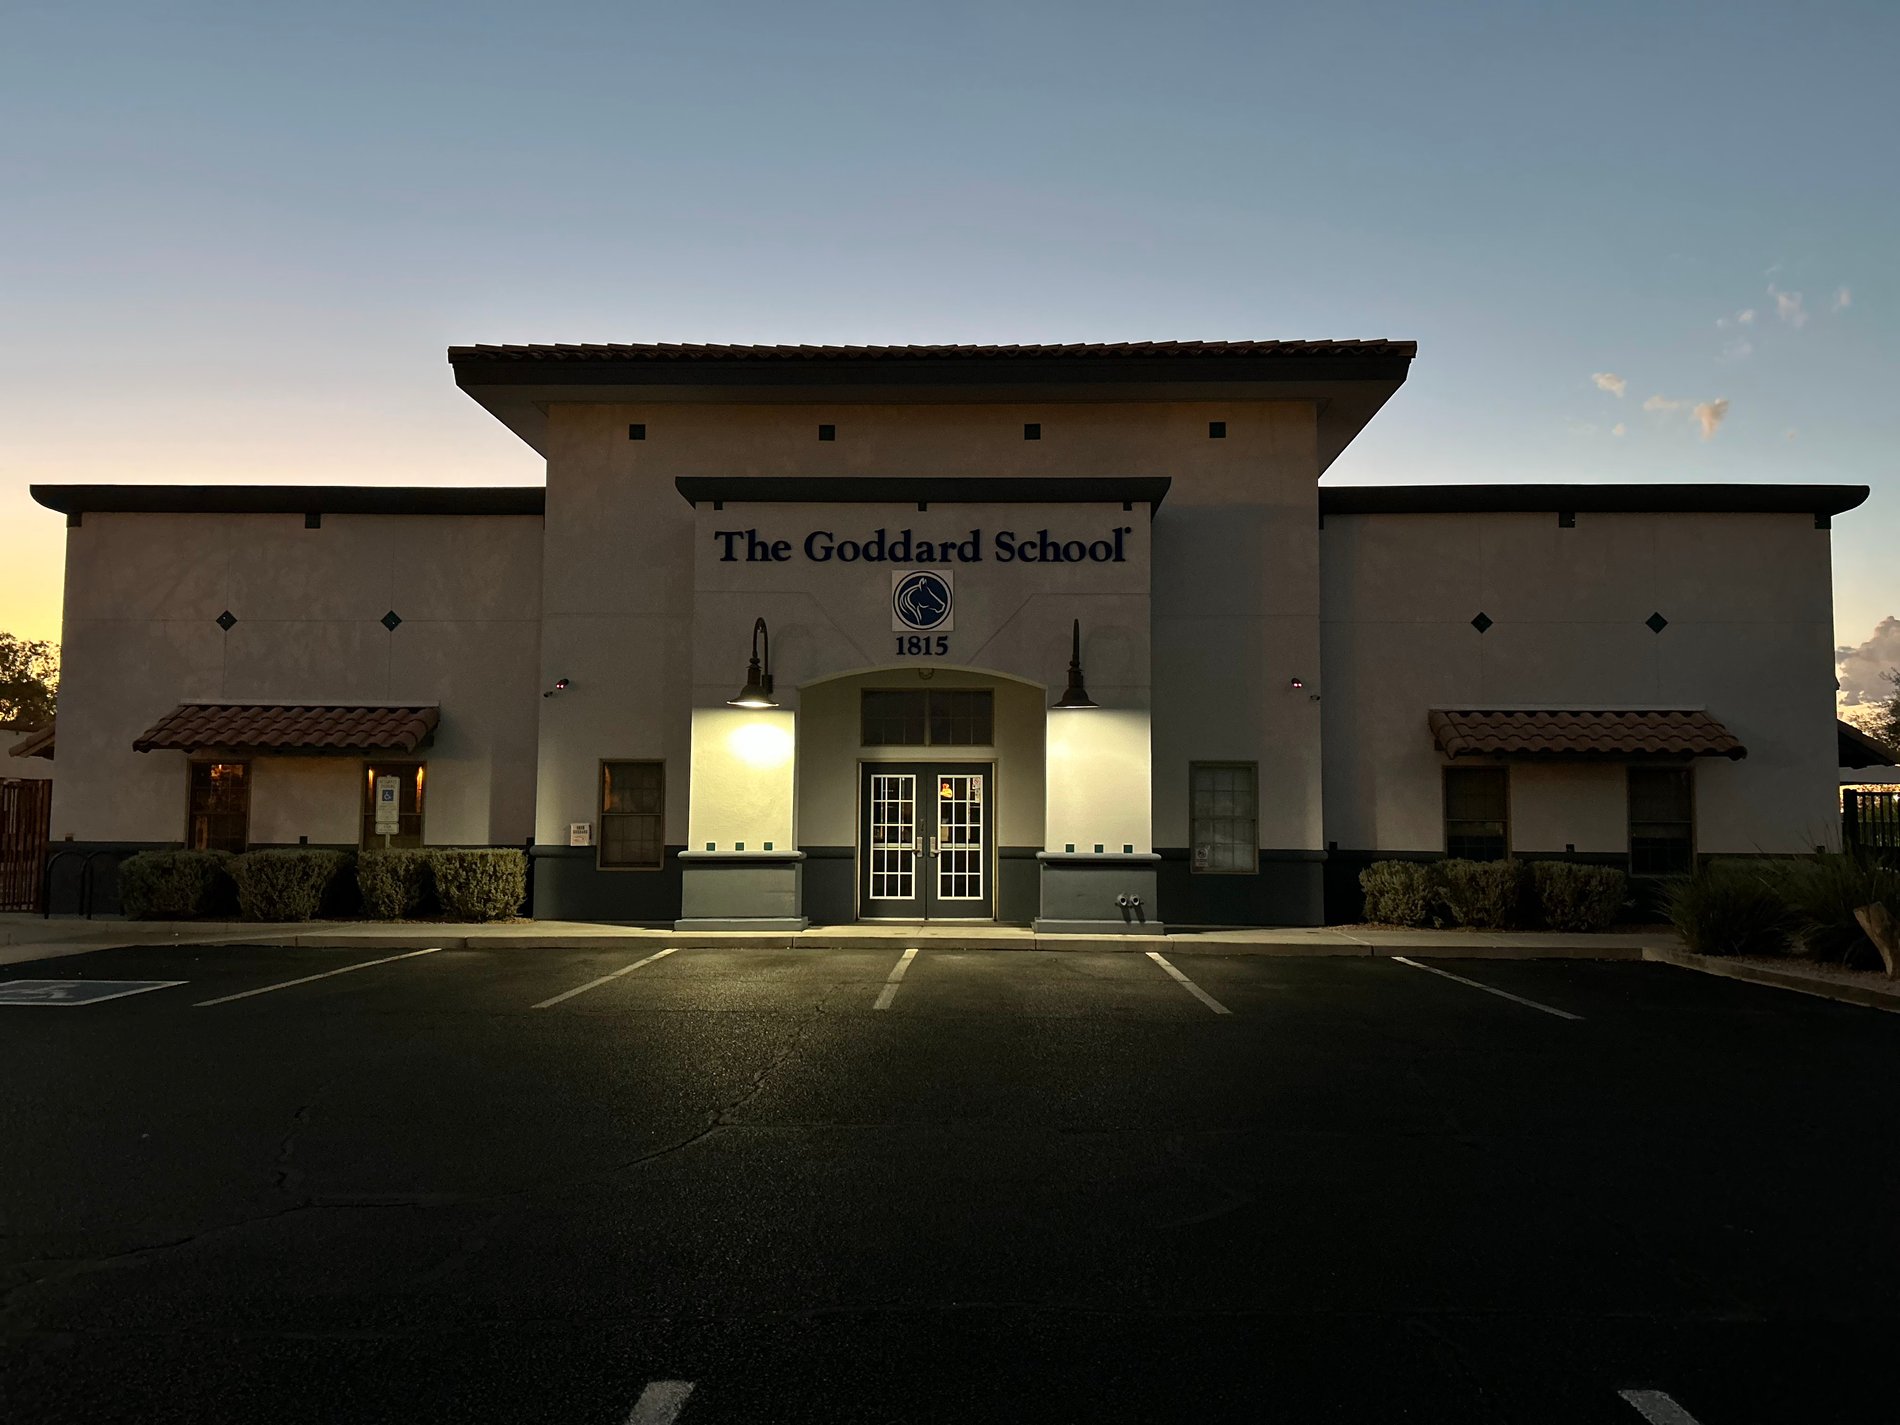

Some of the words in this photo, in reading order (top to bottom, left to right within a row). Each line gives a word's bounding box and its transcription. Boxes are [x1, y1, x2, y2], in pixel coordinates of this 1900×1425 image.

[714, 528, 792, 562] The
[804, 528, 983, 562] Goddard
[995, 527, 1126, 562] School
[896, 635, 949, 656] 1815
